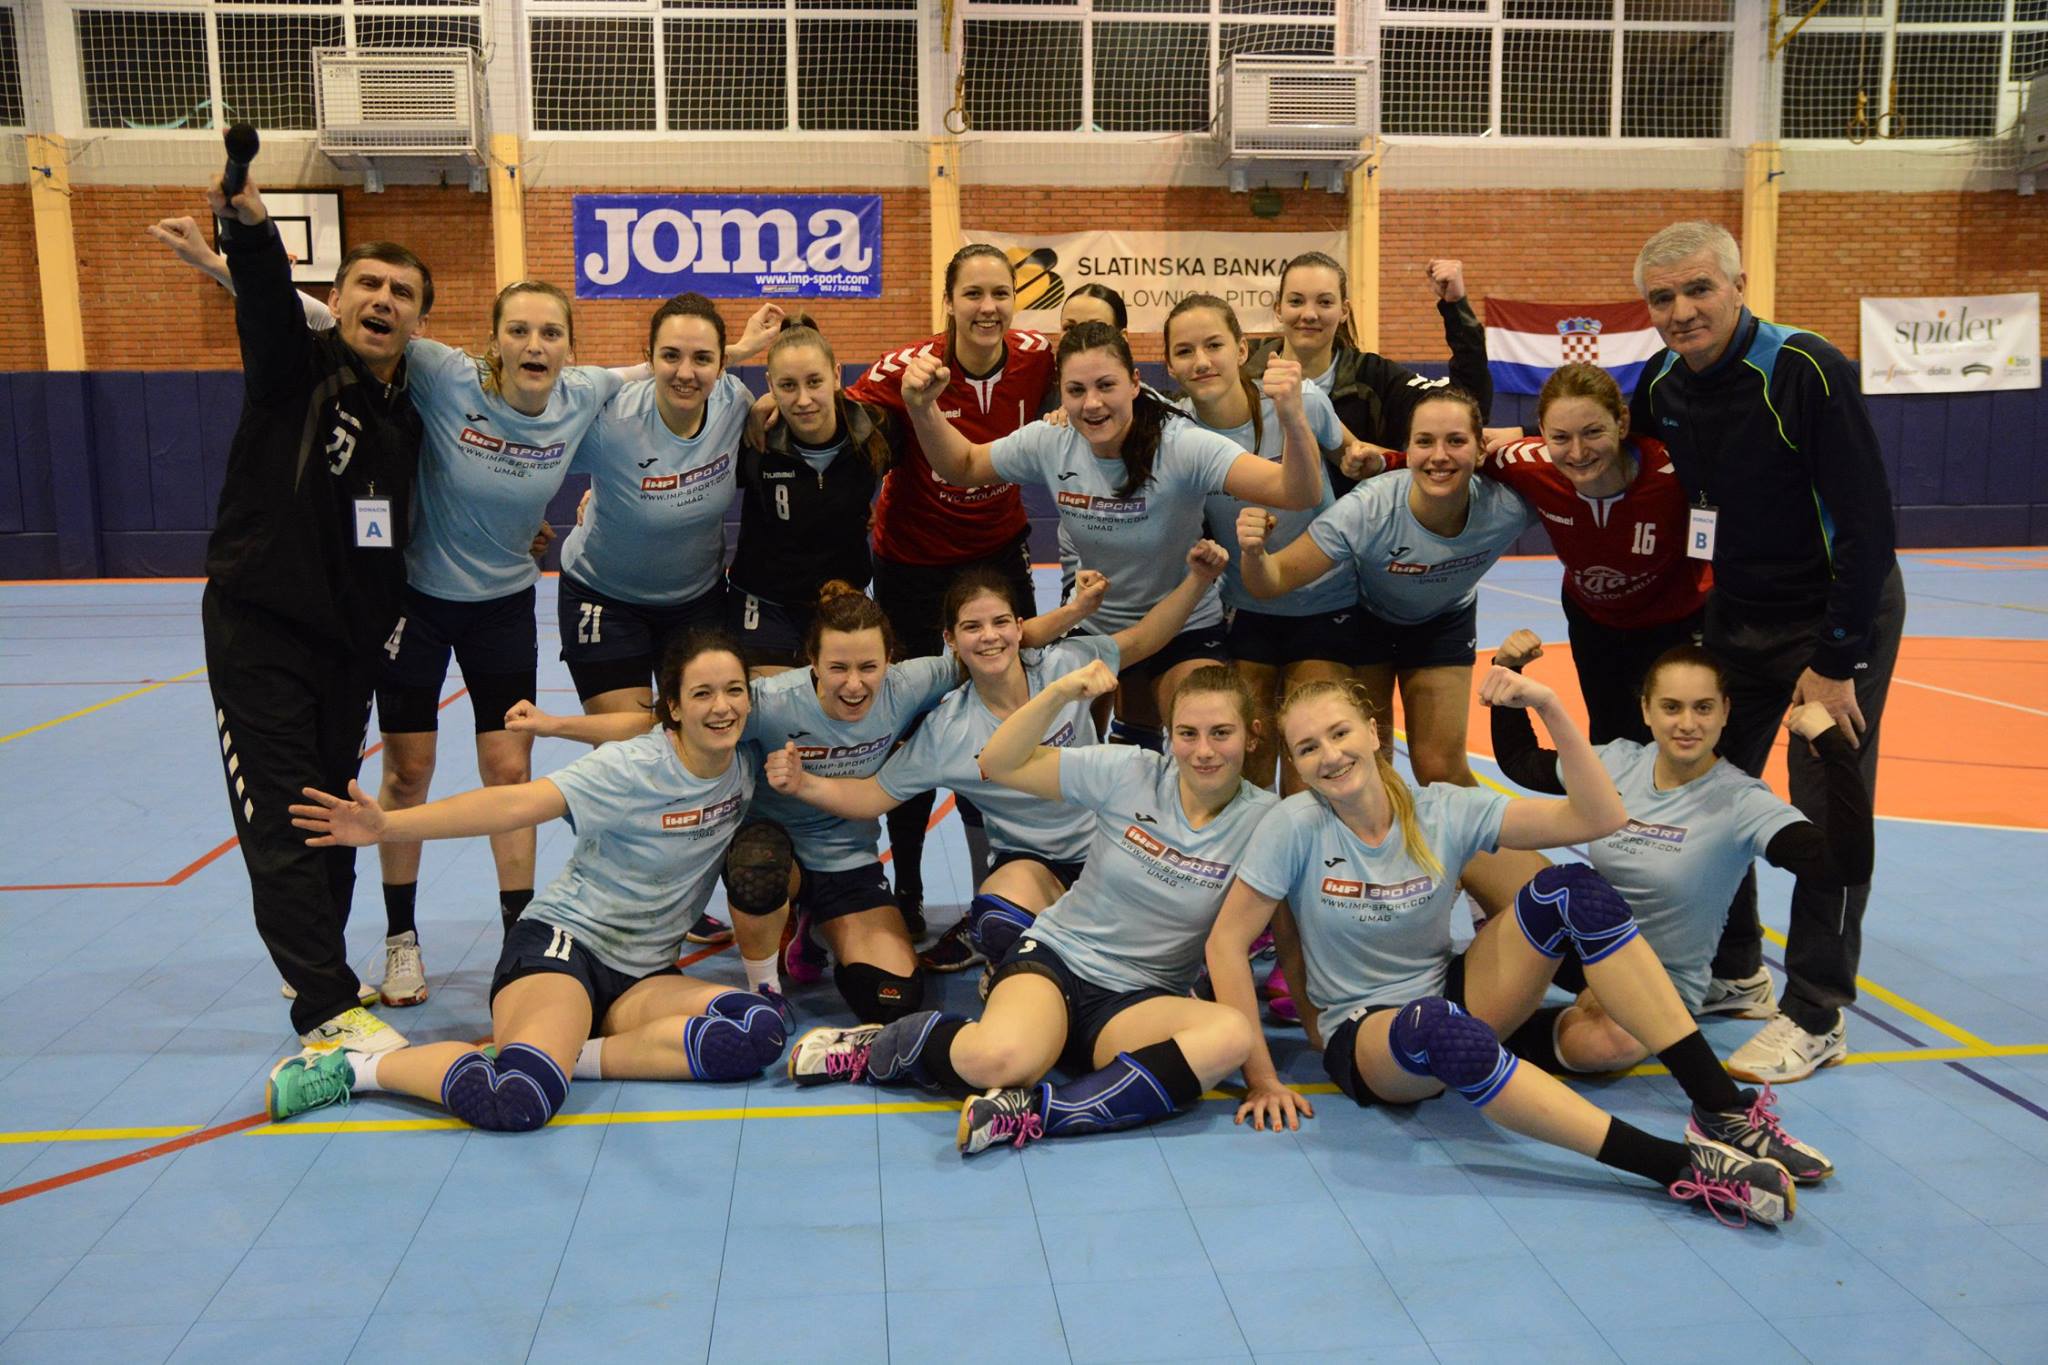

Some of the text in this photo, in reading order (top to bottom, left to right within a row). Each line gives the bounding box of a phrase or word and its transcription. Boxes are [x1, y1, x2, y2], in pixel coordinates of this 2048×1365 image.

[1077, 256, 1290, 277] SLATINSKA BANKA
[755, 272, 869, 287] www.imp-sport.com
[1226, 290, 1281, 308] PITO
[1894, 305, 2003, 355] spider
[509, 446, 562, 458] SPORT
[685, 458, 728, 484] SPORT
[775, 483, 790, 521] 8
[1095, 500, 1142, 511] SPORT
[366, 521, 383, 538] A
[1631, 521, 1657, 556] 16
[1695, 532, 1707, 550] B
[744, 593, 759, 630] 8
[578, 602, 603, 644] 21
[384, 616, 407, 660] 4
[704, 800, 738, 821] SPOR
[1626, 823, 1682, 840] SPORT
[1168, 853, 1225, 876] SPORT
[1146, 868, 1178, 888] UMAG
[1369, 880, 1428, 898] SPORT
[1360, 914, 1392, 922] UMAG
[543, 926, 574, 962] 11
